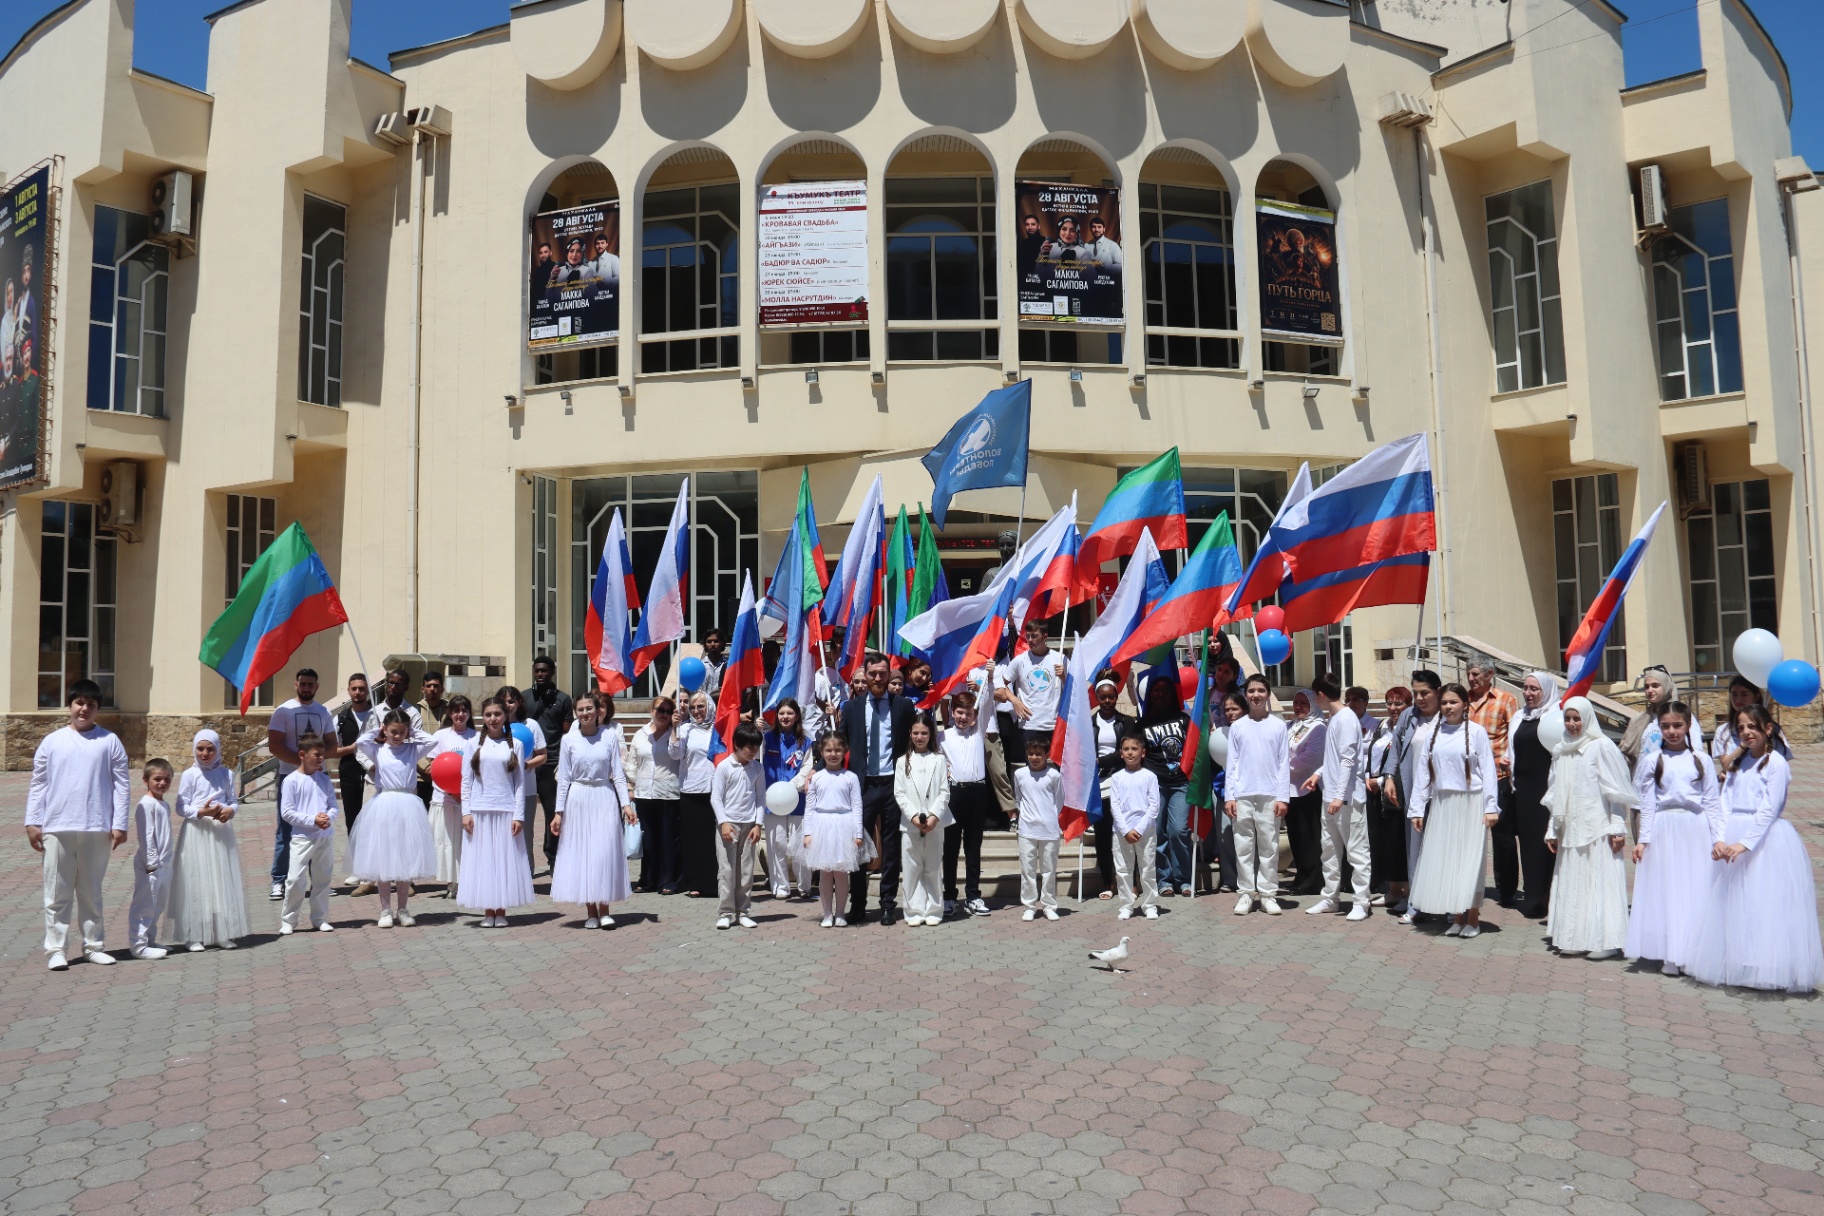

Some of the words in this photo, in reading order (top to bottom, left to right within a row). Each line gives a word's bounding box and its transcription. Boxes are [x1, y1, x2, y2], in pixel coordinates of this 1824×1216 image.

[787, 191, 832, 199] КЪУМУКЪ
[1039, 192, 1052, 202] 28
[1054, 193, 1099, 204] АВГУСТА
[552, 219, 564, 229] 28
[565, 212, 604, 227] АВГУСТА
[761, 259, 790, 267] «БАДЮР
[1055, 270, 1080, 279] МАККА
[1046, 280, 1089, 290] САГАИПОВА
[560, 290, 583, 301] МАККА
[791, 294, 837, 302] НАСРУТДИН»
[1267, 284, 1297, 298] ПУТЬ
[1298, 287, 1332, 303] ГОРЦА
[553, 299, 590, 312] САГАИПОВА
